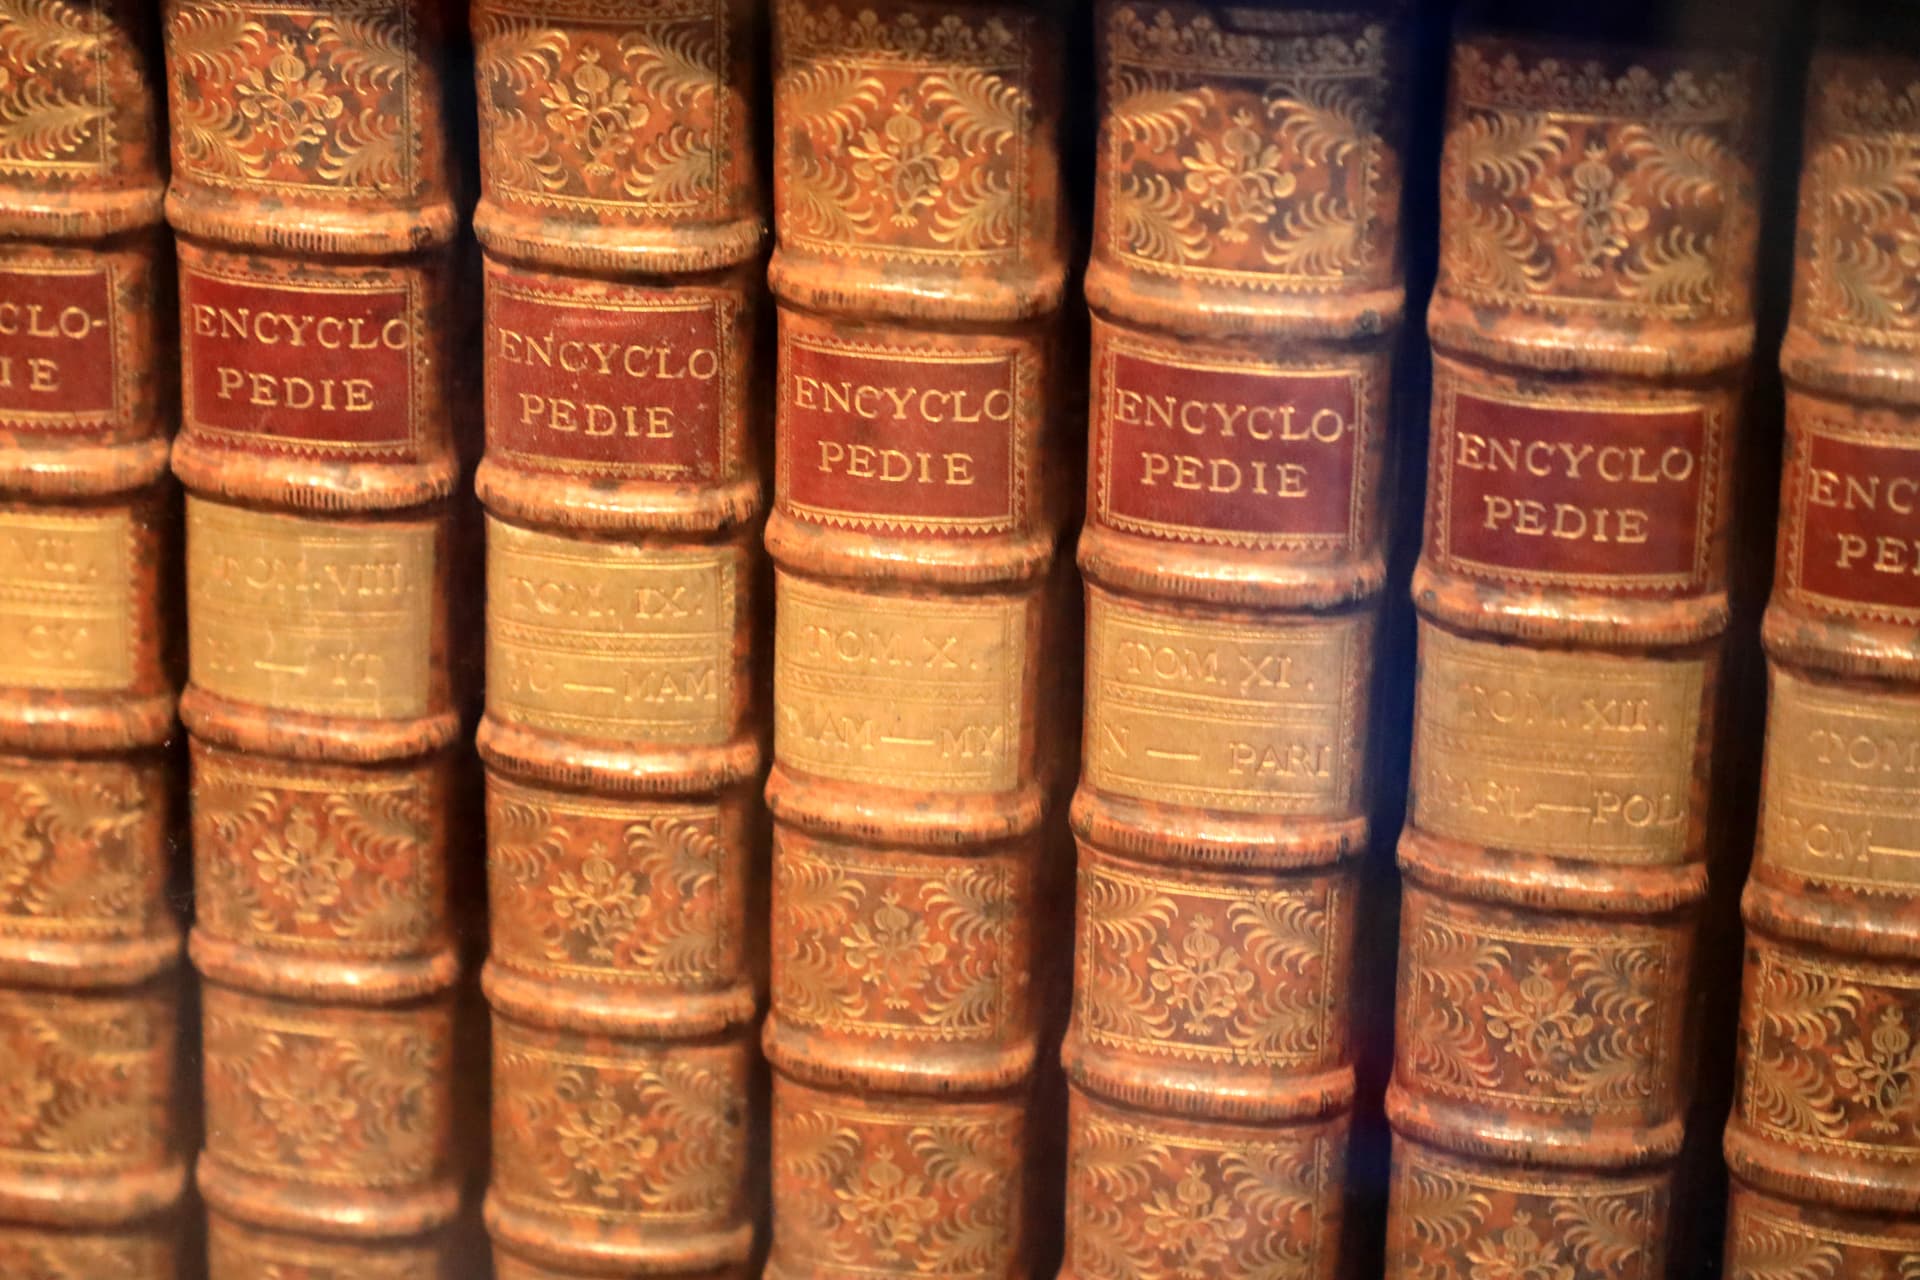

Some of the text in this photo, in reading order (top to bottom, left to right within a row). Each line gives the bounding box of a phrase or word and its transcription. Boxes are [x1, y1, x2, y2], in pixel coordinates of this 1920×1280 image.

[193, 304, 411, 350] ENCYCLO
[500, 328, 719, 380] ENCYCLO
[216, 367, 374, 412] PEDIE
[794, 375, 1013, 424] ENCYCLO
[519, 393, 676, 439] PEDIE
[818, 440, 976, 485] PEDIE
[1140, 451, 1308, 498] PEDIE
[1456, 431, 1694, 483] ENCYCLO
[1808, 467, 1919, 515] ENC
[1483, 494, 1649, 543] PEDIE
[1119, 641, 1227, 687] TOM.
